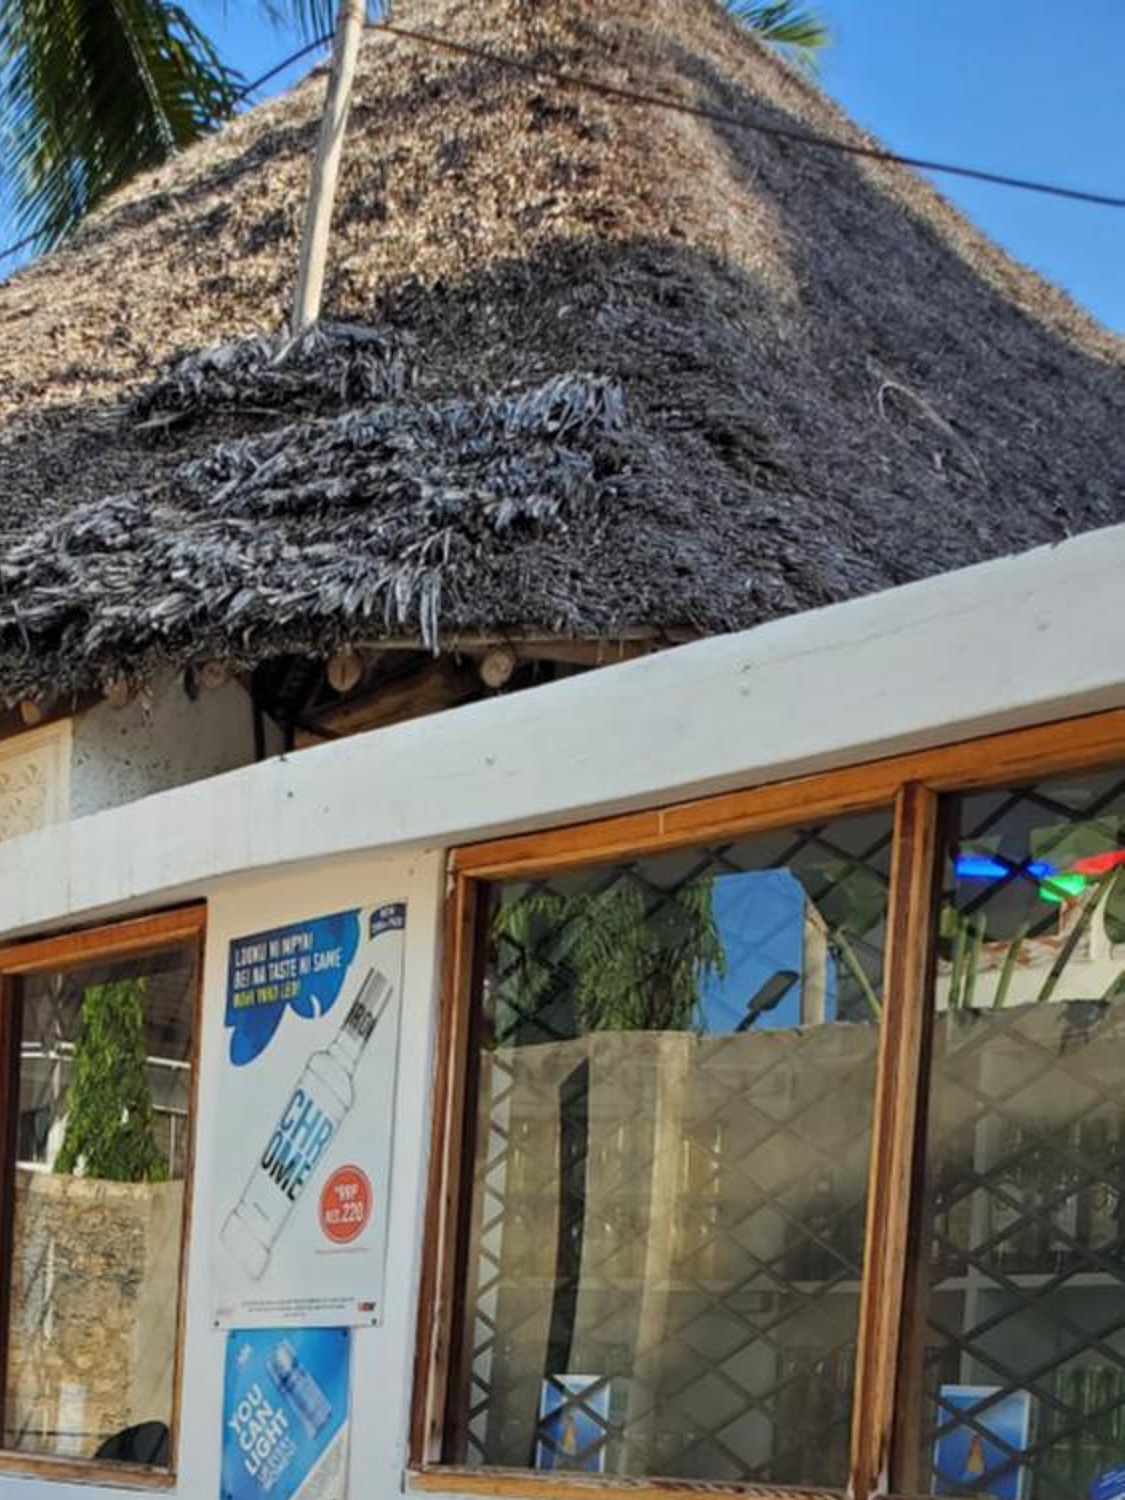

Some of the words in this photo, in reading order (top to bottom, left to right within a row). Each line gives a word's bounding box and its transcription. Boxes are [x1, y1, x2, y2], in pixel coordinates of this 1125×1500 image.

[234, 967, 251, 990] BEI
[251, 964, 267, 985] NA
[267, 957, 298, 982] TASTE
[312, 946, 344, 973] SAME
[228, 1383, 263, 1434] YOU
[239, 1399, 274, 1451] CAN
[243, 1408, 288, 1477] LIGHT
